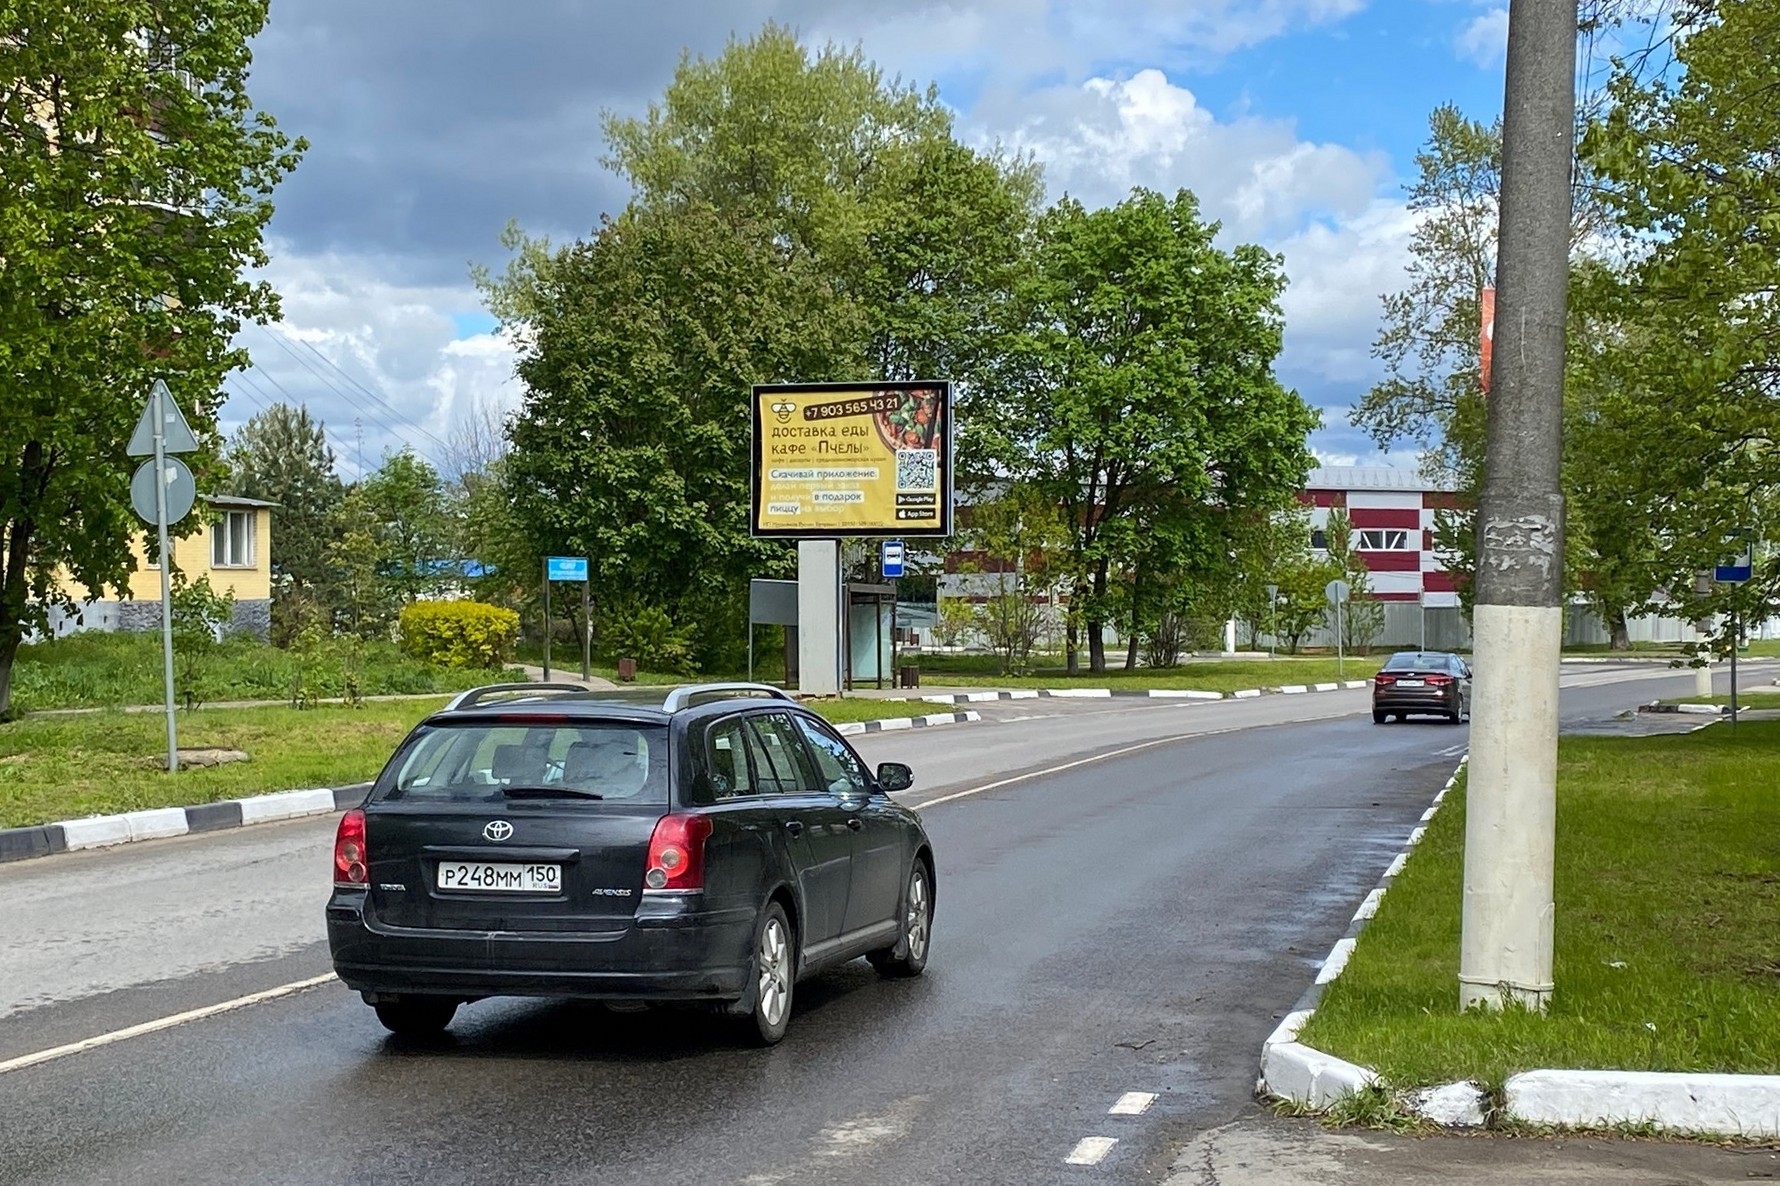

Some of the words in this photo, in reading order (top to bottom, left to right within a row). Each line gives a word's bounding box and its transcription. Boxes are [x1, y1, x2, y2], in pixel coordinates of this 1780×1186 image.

[805, 407, 818, 418] +7
[821, 404, 843, 416] 903
[845, 401, 868, 413] 565
[870, 399, 884, 411] 43
[886, 397, 898, 408] 21
[771, 426, 836, 438] доставка
[841, 426, 869, 437] еды
[771, 443, 806, 455] кафе
[770, 469, 814, 479] Скачивай
[822, 494, 862, 503] подарок
[769, 504, 799, 515] пиццу
[526, 866, 556, 883] 150
